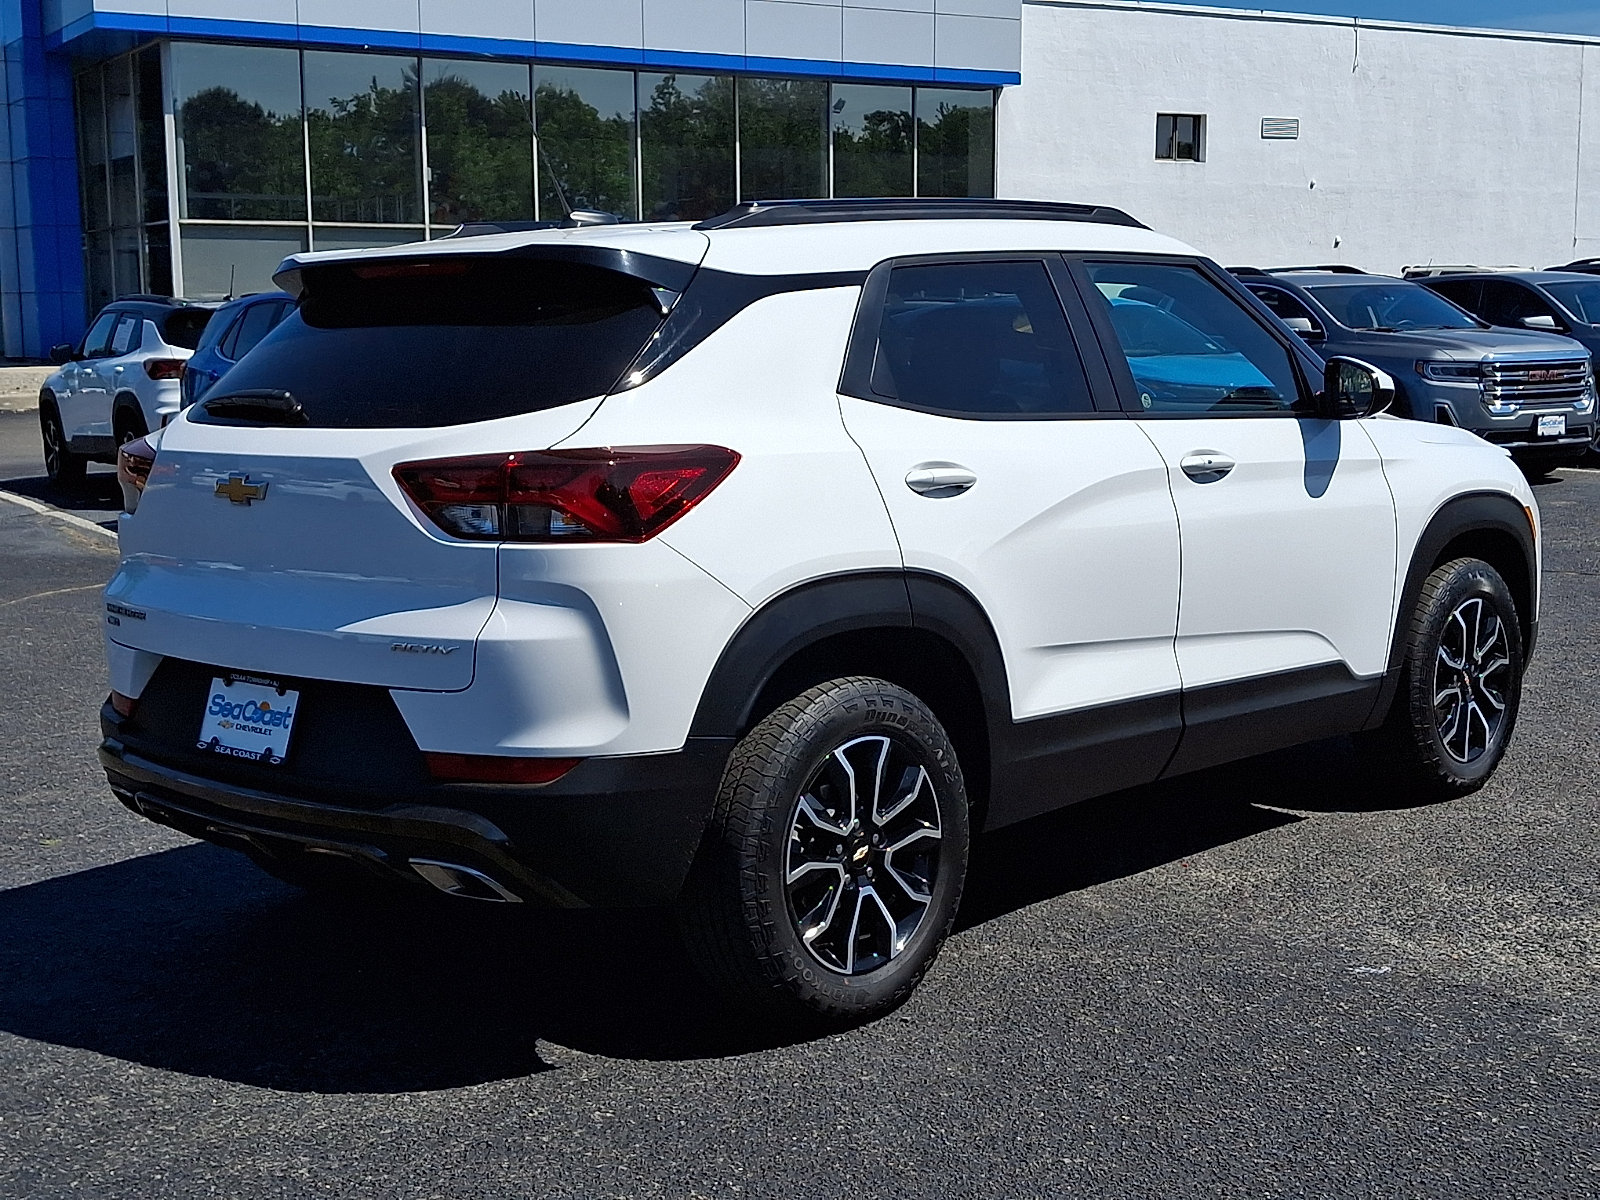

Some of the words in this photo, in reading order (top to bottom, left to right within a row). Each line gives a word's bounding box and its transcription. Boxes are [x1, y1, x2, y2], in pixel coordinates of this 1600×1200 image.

[1528, 369, 1565, 382] GMC
[391, 642, 460, 655] ACTIV
[235, 722, 273, 736] CHEVROLET
[214, 745, 232, 755] SEA
[232, 749, 262, 760] COAST
